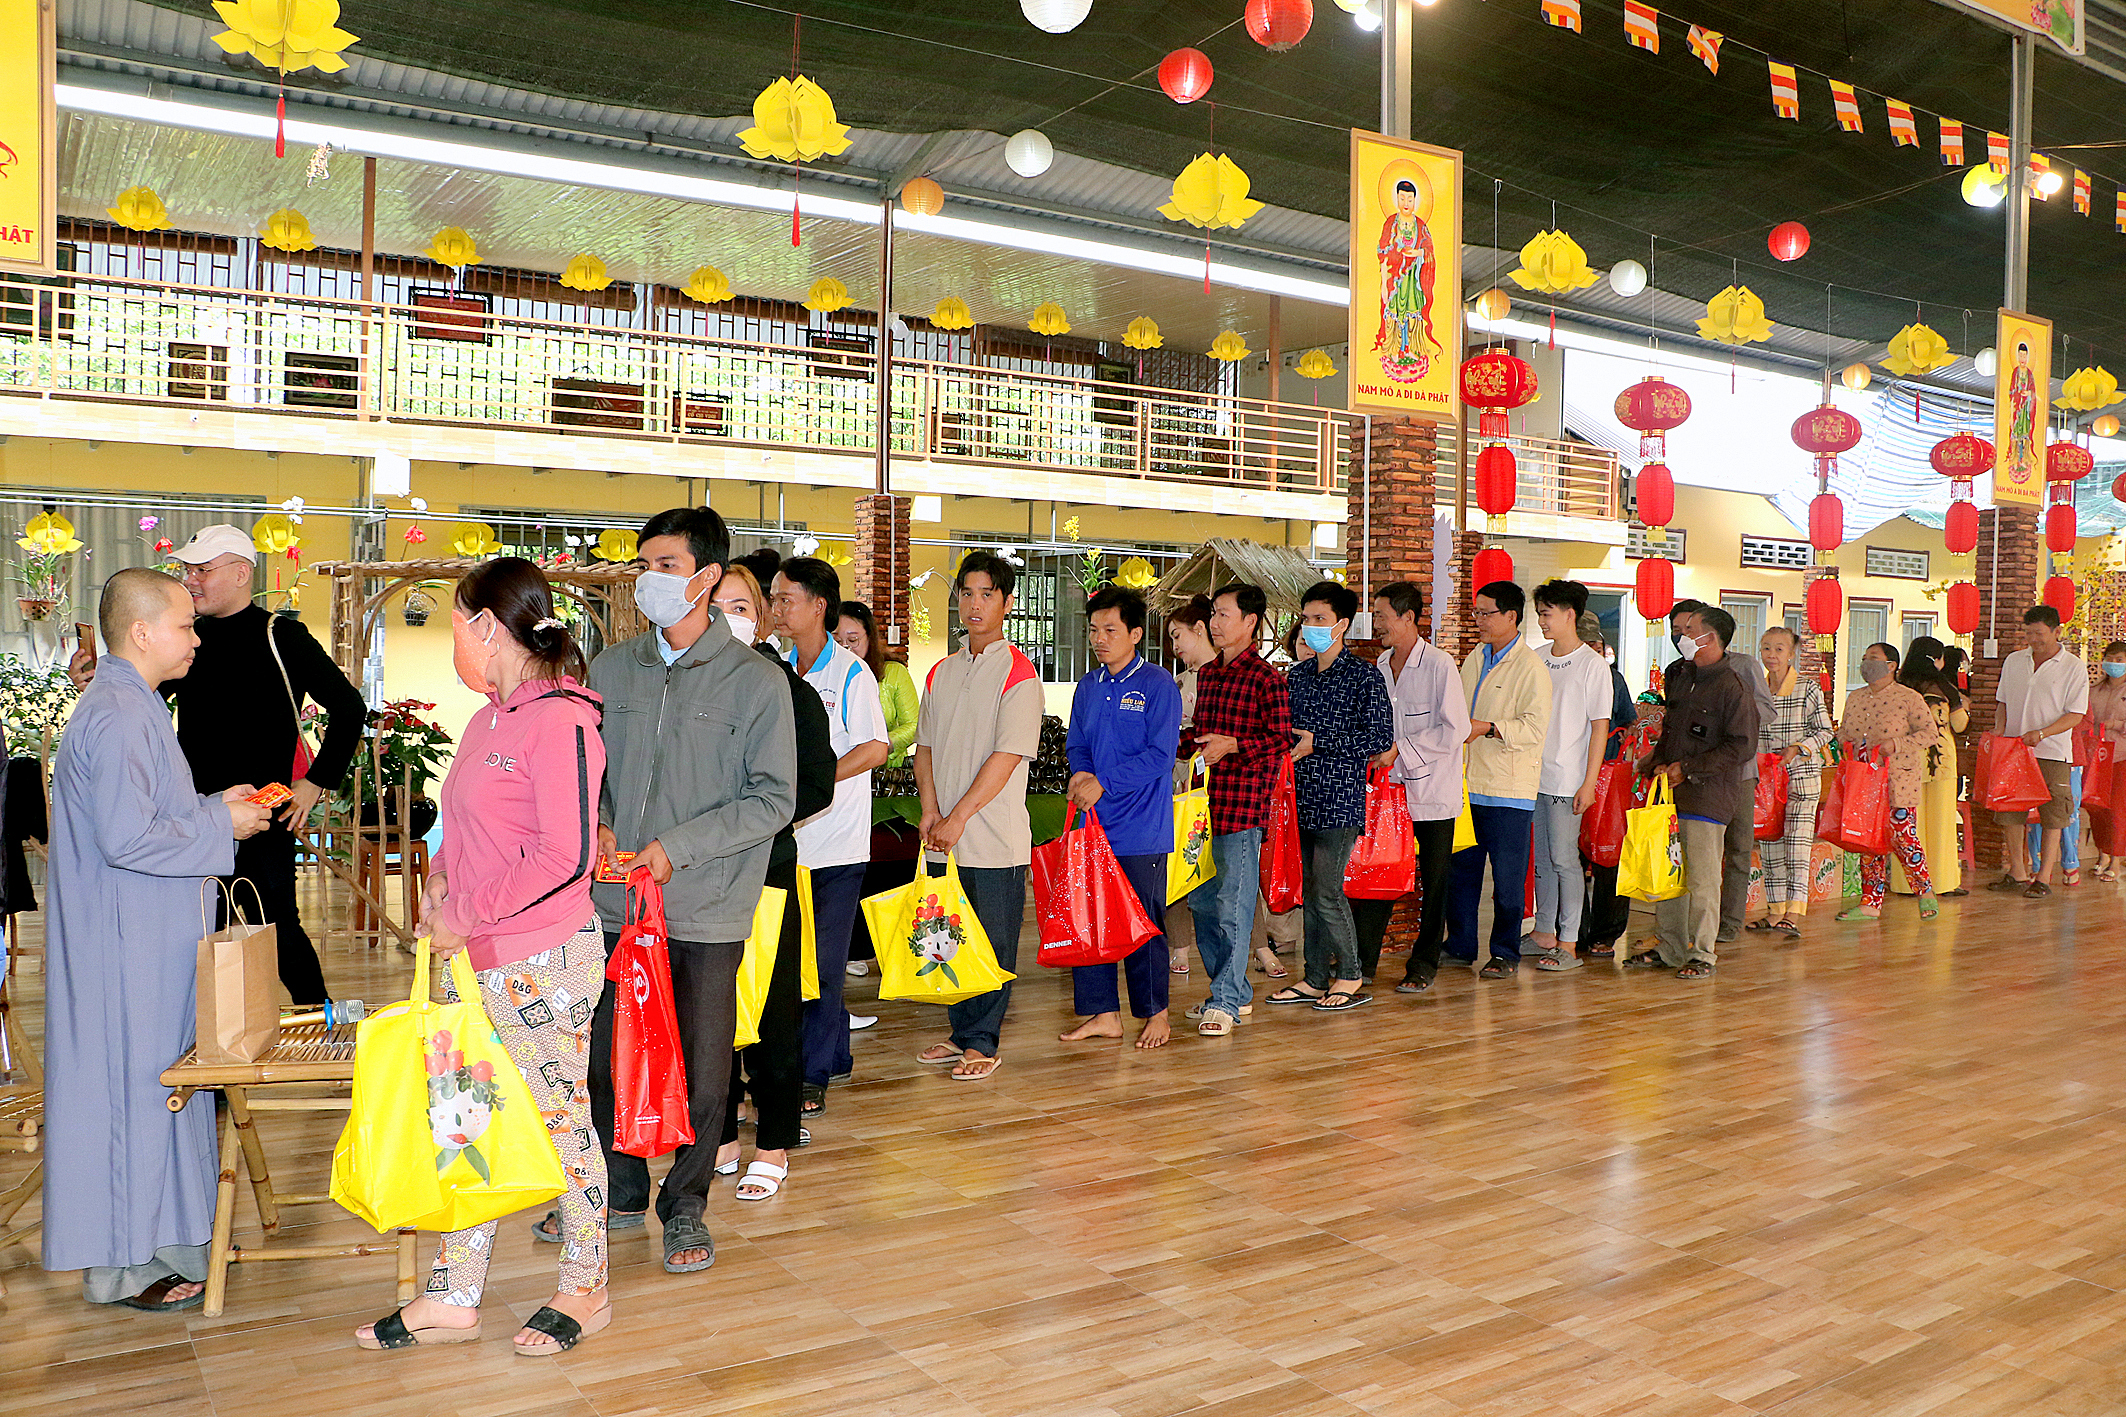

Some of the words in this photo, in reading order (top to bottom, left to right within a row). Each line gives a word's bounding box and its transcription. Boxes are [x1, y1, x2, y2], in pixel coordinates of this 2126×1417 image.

[1358, 384, 1377, 395] NAM
[1380, 386, 1394, 397] MÔ
[1396, 389, 1402, 398] A
[1404, 390, 1413, 399] DI
[1428, 392, 1449, 404] PHẬT
[484, 752, 517, 772] LOVE
[1043, 939, 1072, 949] DENNER
[512, 979, 532, 994] D&G
[546, 1113, 564, 1130] D&G
[574, 1167, 590, 1176] D&
